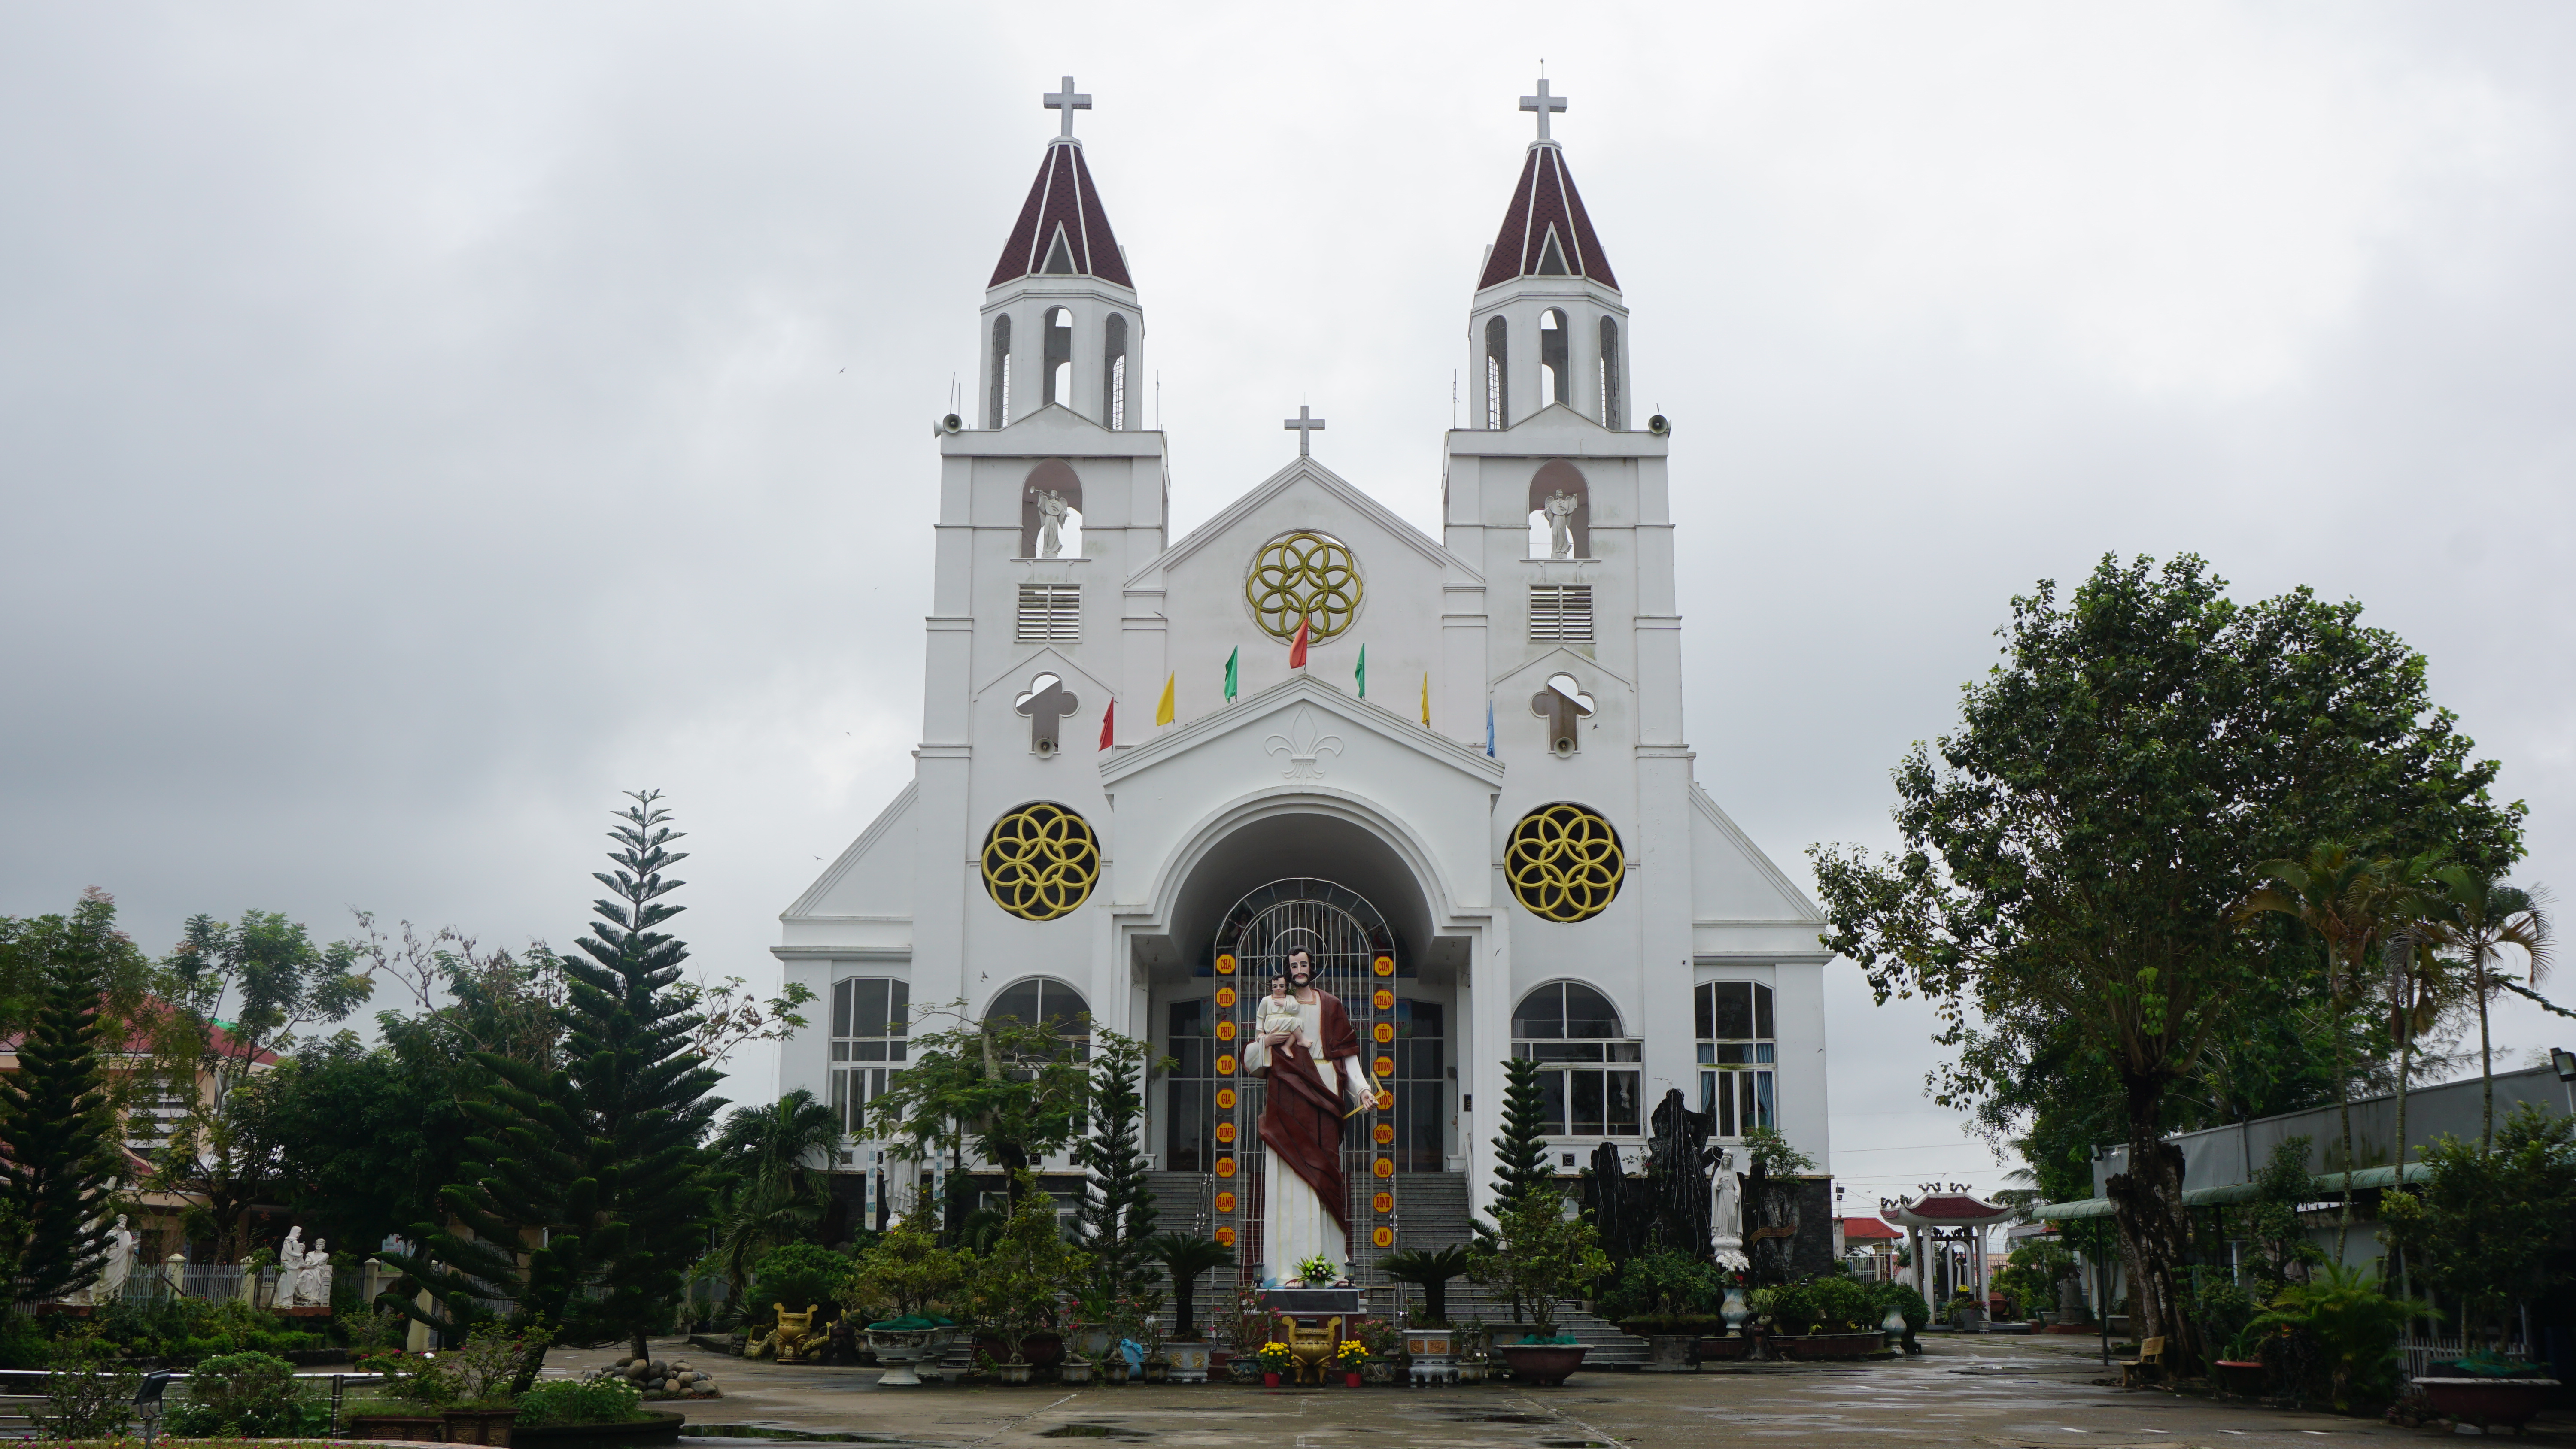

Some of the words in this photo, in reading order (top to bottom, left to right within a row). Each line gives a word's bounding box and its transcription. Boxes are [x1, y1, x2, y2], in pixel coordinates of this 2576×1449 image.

[1221, 959, 1232, 970] CHA
[1378, 961, 1389, 971] CON
[1376, 991, 1391, 1006] THẢO
[1221, 1023, 1232, 1038] PHÙ
[1378, 1025, 1389, 1040] YÊU
[1221, 1059, 1232, 1073] TRỢ
[1375, 1061, 1392, 1072] THƯƠNG
[1221, 1093, 1231, 1104] GIA
[1379, 1093, 1391, 1108] UỘC
[1219, 1124, 1233, 1138] ĐÌNH
[1376, 1125, 1391, 1140] SỐNG
[1218, 1159, 1233, 1173] LUÔN
[1378, 1160, 1388, 1175] MÃI
[1218, 1197, 1233, 1210] HẠNH
[1376, 1194, 1390, 1208] BÌNH
[1218, 1229, 1233, 1242] PHÚC
[1379, 1231, 1387, 1243] AN
